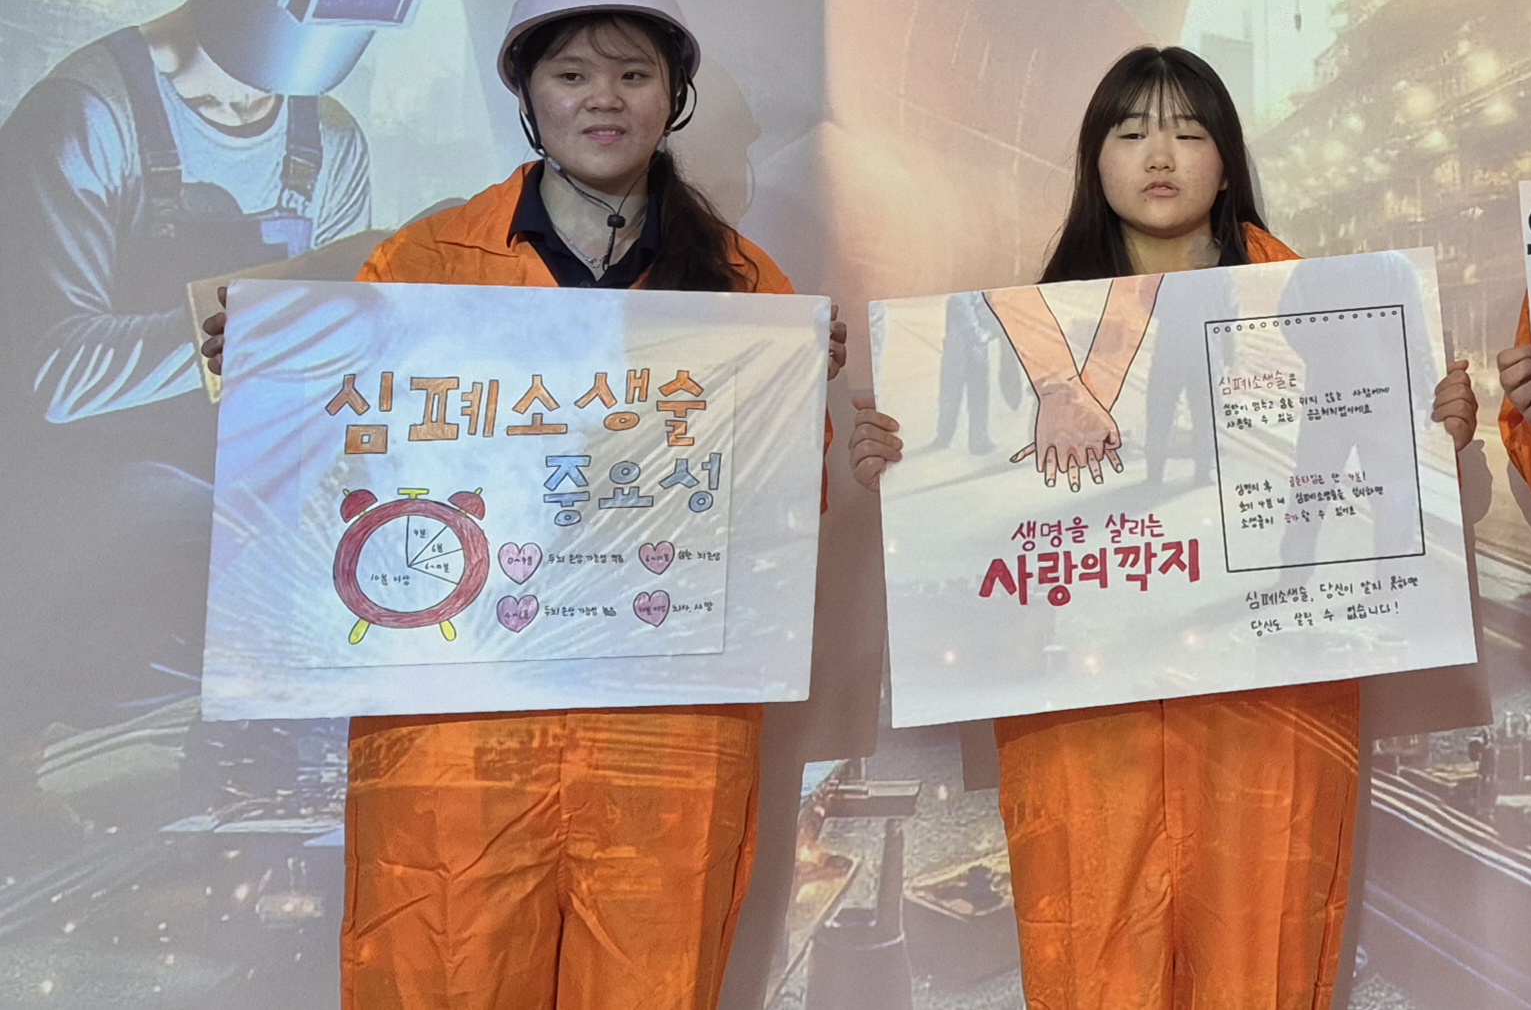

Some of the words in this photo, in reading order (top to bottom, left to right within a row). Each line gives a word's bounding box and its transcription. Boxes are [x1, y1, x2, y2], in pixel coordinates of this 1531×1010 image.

[1218, 370, 1297, 395] 심폐소생술은
[325, 368, 707, 455] 심폐소생술
[1261, 415, 1269, 424] 수
[543, 452, 722, 527] 중요성
[1011, 516, 1089, 552] 생명을
[1105, 512, 1165, 544] 살리는
[1319, 509, 1325, 520] 수
[978, 547, 1108, 607] 사랑의
[1114, 538, 1200, 591] 깍지
[1320, 582, 1353, 599] 당신이
[1360, 580, 1382, 595] 알지
[1390, 575, 1419, 591] 못하면
[1251, 619, 1282, 637] 당신도
[1294, 612, 1314, 626] 살릴
[1323, 608, 1334, 622] 수
[1347, 601, 1399, 621] 없습니다!
